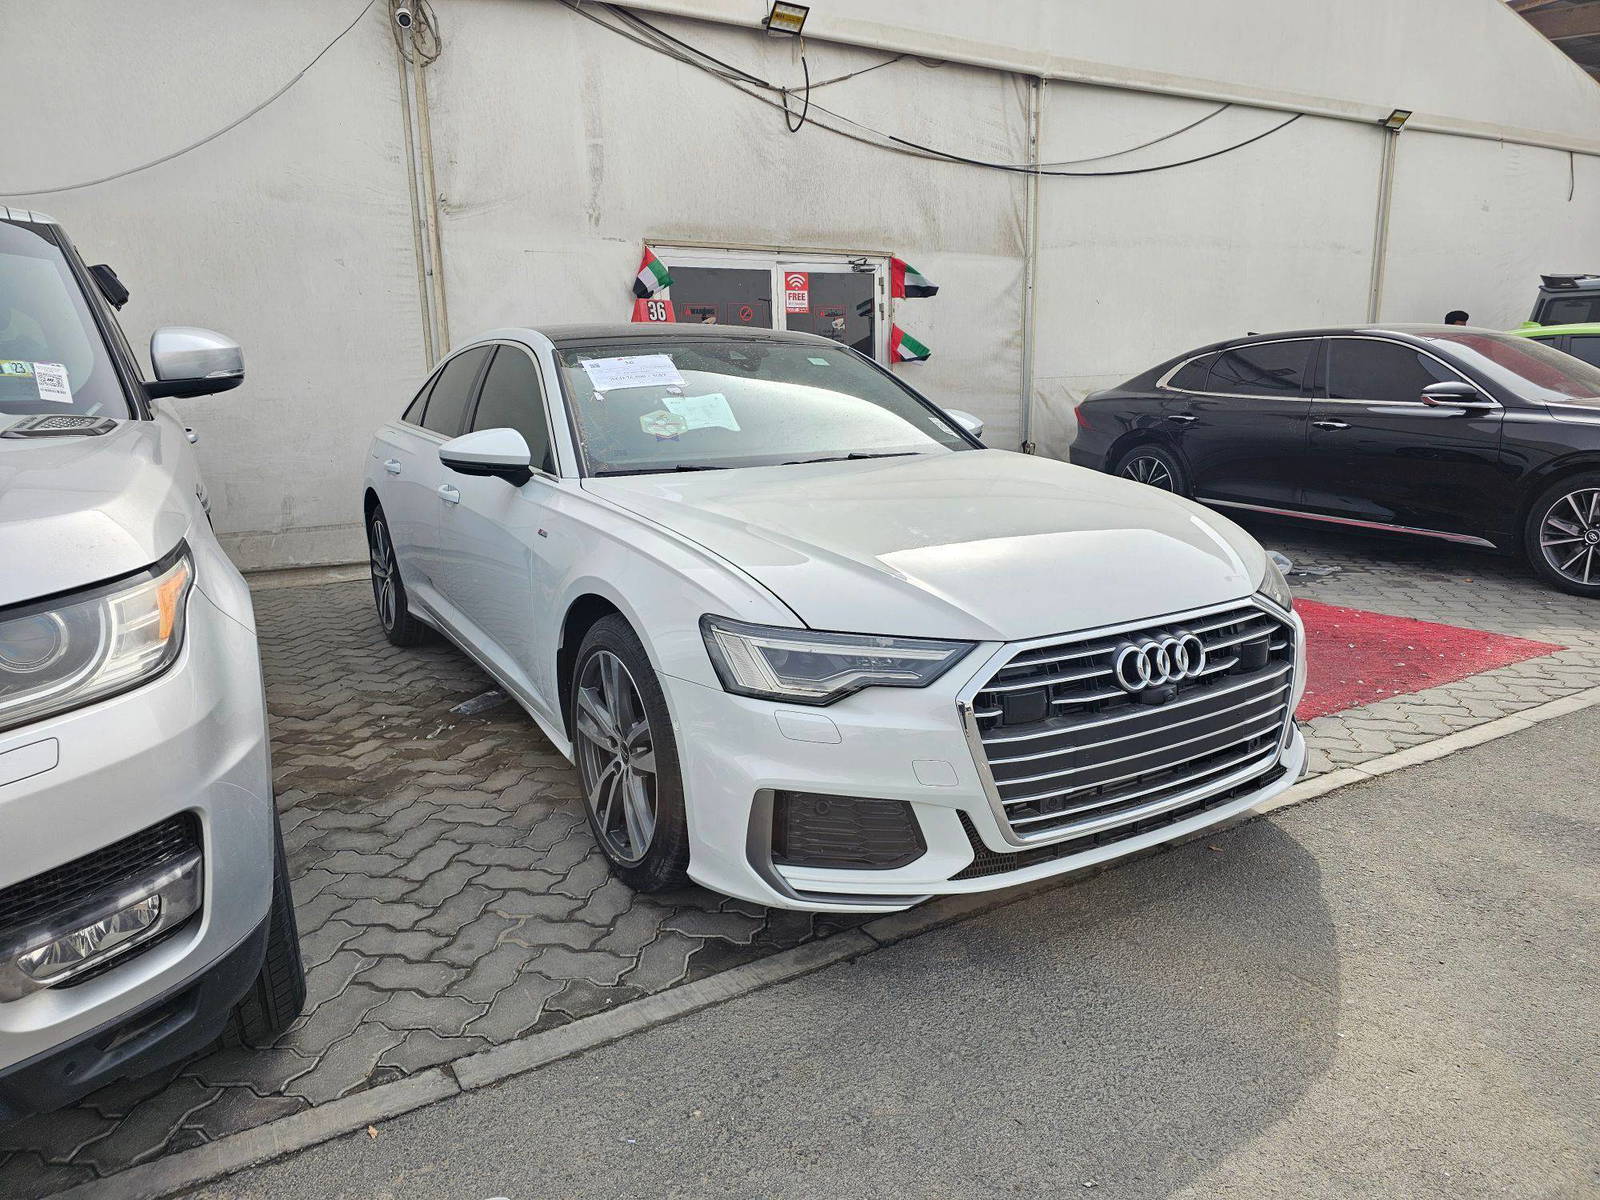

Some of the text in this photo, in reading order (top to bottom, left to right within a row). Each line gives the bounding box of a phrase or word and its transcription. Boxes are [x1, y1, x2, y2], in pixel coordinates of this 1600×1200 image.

[788, 293, 806, 301] FREE
[647, 301, 666, 321] 36
[13, 362, 26, 374] 23
